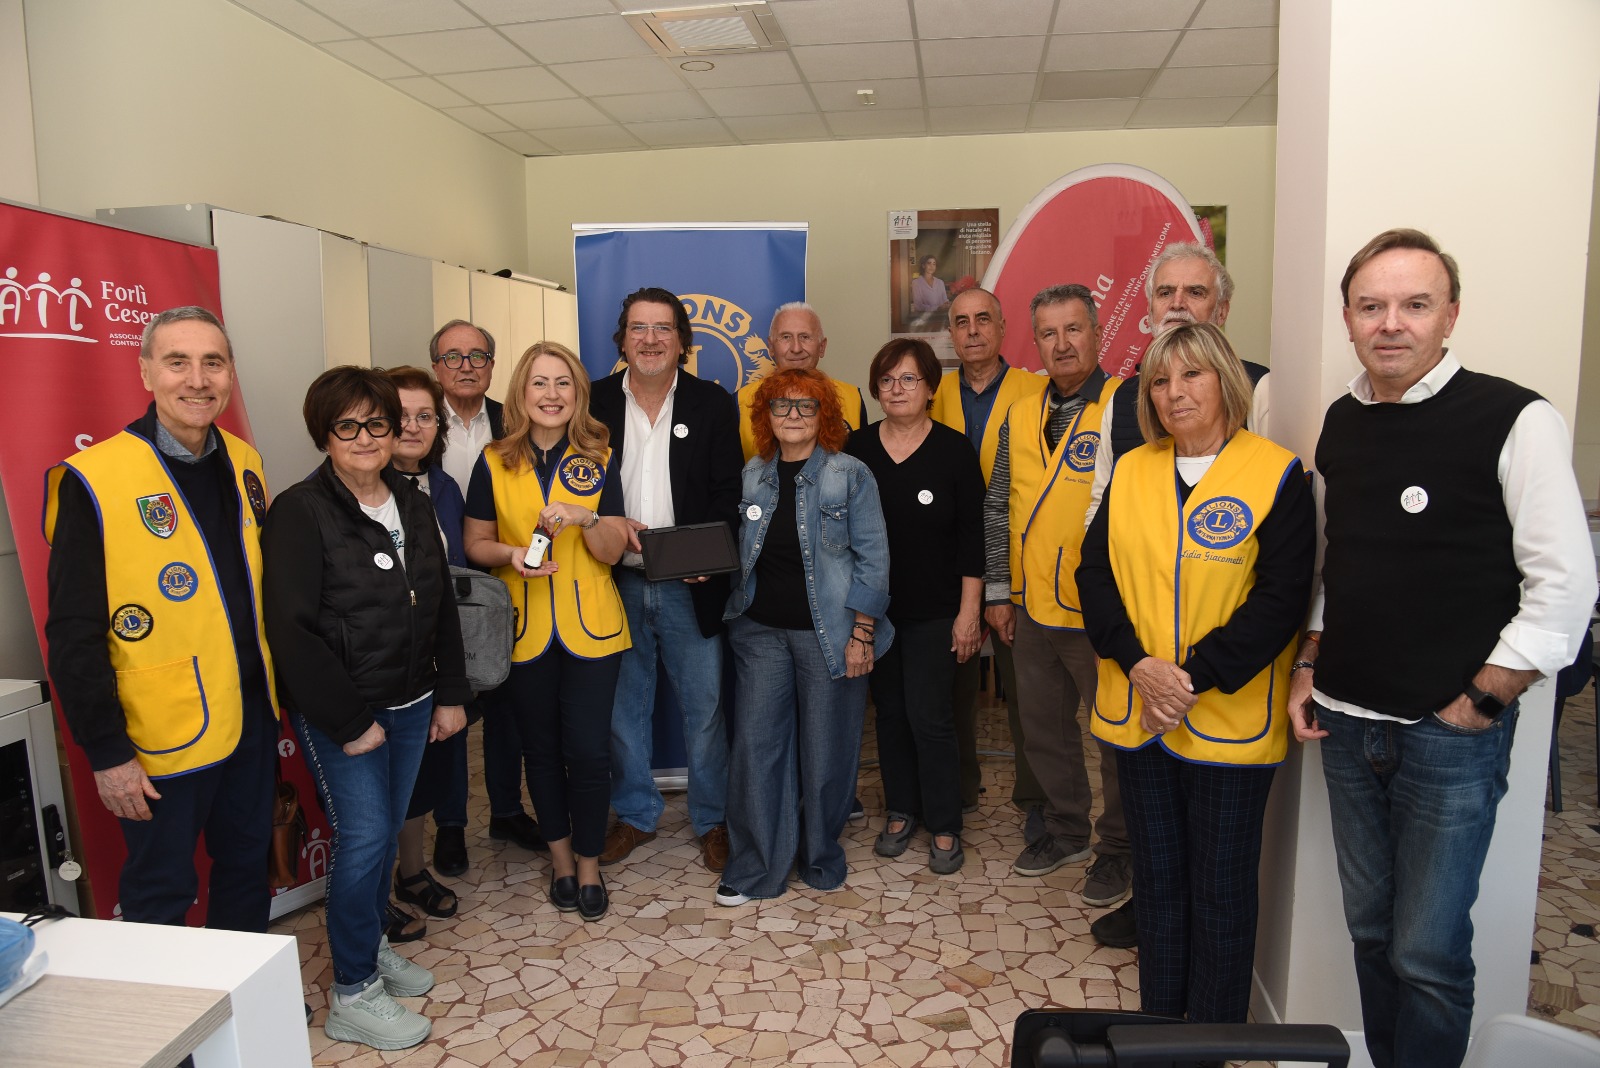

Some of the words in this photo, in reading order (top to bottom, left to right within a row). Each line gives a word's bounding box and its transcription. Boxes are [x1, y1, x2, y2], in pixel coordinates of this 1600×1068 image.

[1109, 302, 1132, 341] LEUCEMIE
[1131, 264, 1152, 298] LINFOMI
[1151, 222, 1172, 258] MIELOMA
[101, 280, 148, 305] Forlì
[1114, 277, 1137, 314] ITALIANA
[109, 333, 144, 341] ASSOCIAZ
[1079, 443, 1091, 457] L
[572, 458, 596, 468] LIONS
[577, 467, 588, 480] L
[1209, 501, 1240, 513] LIONS
[155, 509, 165, 519] L
[1211, 512, 1228, 528] L
[1197, 530, 1234, 541] INTERNATIONAL
[174, 575, 183, 586] L
[126, 617, 138, 629] L
